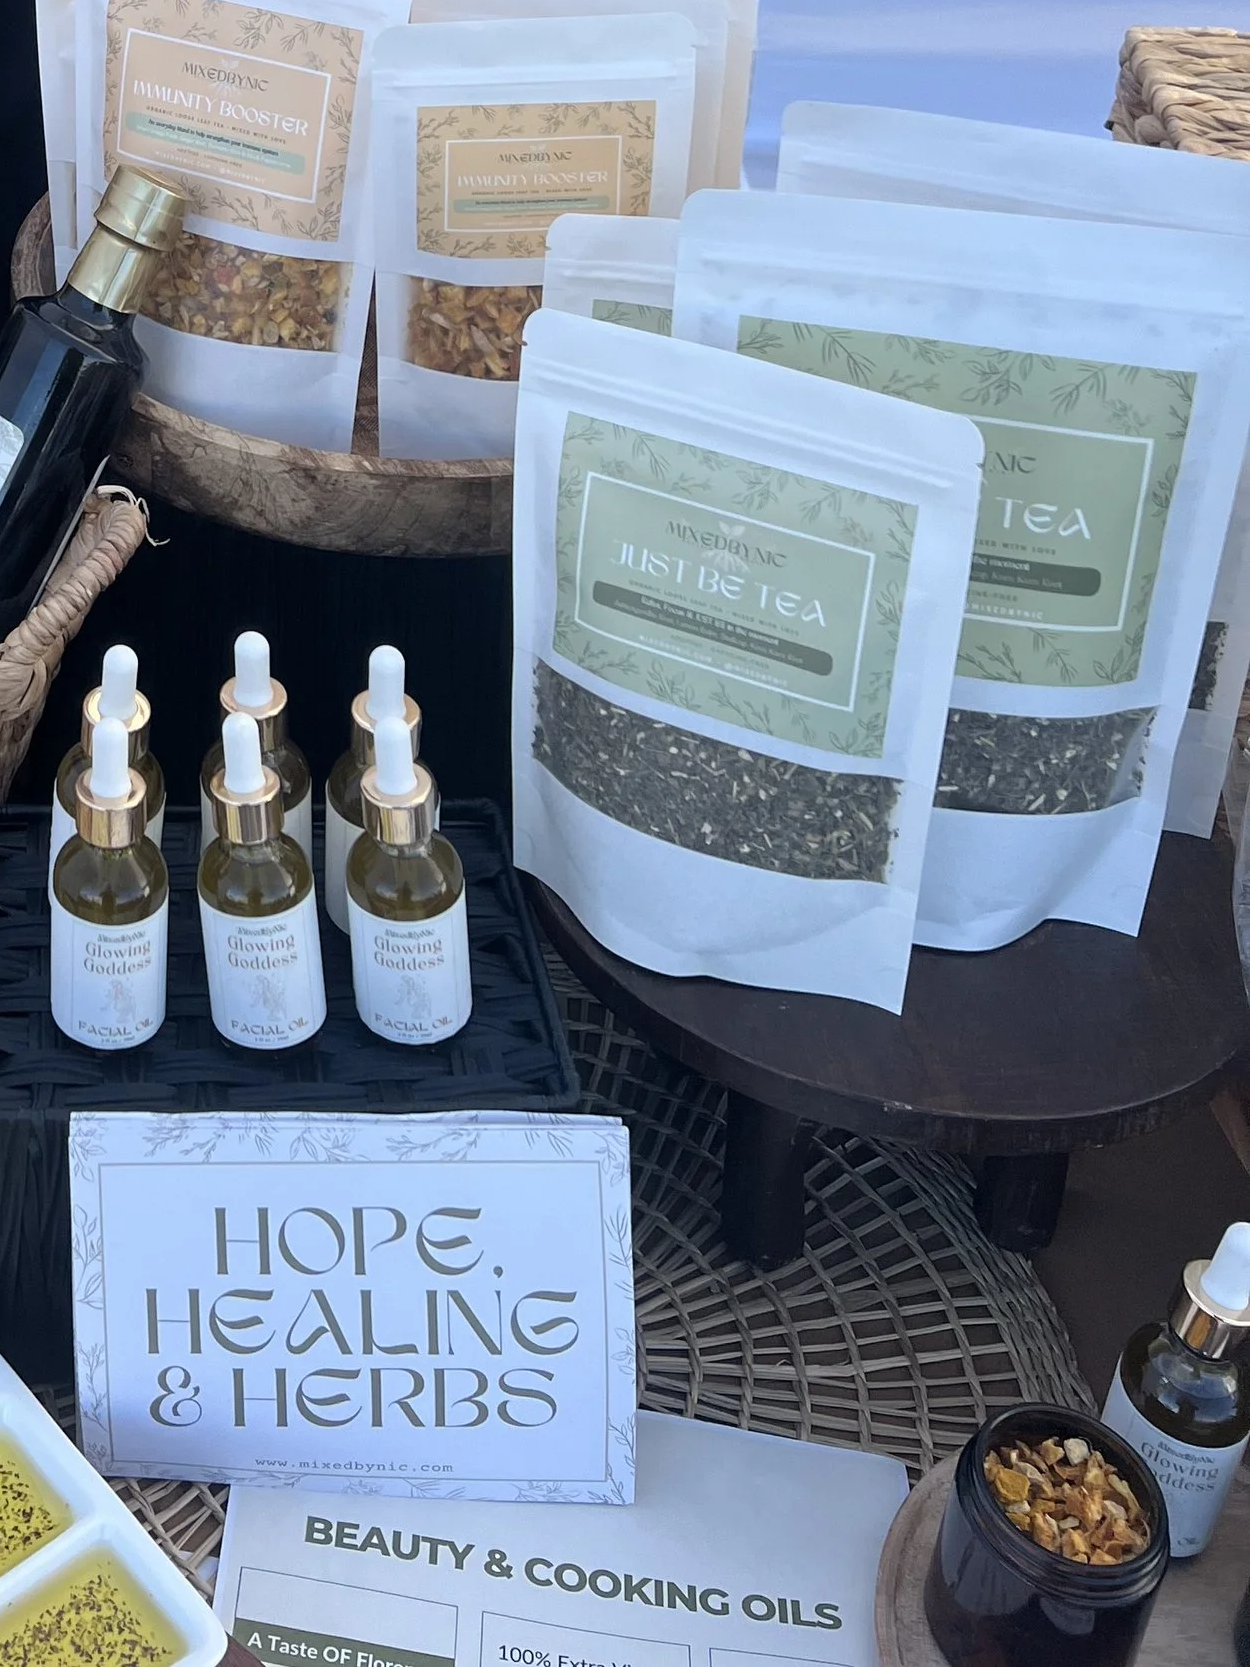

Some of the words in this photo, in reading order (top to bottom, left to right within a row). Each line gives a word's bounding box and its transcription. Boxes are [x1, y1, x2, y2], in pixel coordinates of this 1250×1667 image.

[181, 61, 269, 93] MIXEDBYNIC
[133, 79, 218, 113] IMMUNITY
[220, 100, 308, 137] BOOSTER
[533, 171, 608, 185] BOOSTER
[994, 496, 1091, 540] TEA
[665, 520, 787, 570] MIXEDBYNIC
[610, 540, 692, 585] JUST
[698, 565, 746, 603] BE
[754, 582, 826, 628] TEA
[86, 940, 151, 959] Glowing
[228, 934, 295, 953] Glowing
[374, 935, 443, 955] Glowing
[84, 957, 151, 975] Goddess
[228, 951, 298, 970] Goddess
[374, 951, 445, 971] Goddess
[78, 1020, 132, 1037] FACIAL
[231, 1019, 285, 1036] FACIAL
[375, 1013, 429, 1032] FACIAL
[213, 1207, 504, 1279] HOPE,
[145, 1288, 579, 1356] HEALING
[149, 1365, 203, 1428] &
[232, 1367, 558, 1428] HERBS
[255, 1458, 454, 1473] www.mixedbynic.com
[1141, 1442, 1219, 1480] Glowing
[1152, 1469, 1215, 1492] ddess
[303, 1516, 475, 1572] BEAUTY
[483, 1549, 514, 1580] &
[525, 1558, 729, 1617] COOKING
[740, 1594, 843, 1630] OILS
[247, 1632, 262, 1649] A
[268, 1635, 318, 1659] Taste
[323, 1646, 352, 1665] OF
[499, 1645, 552, 1667] 100%
